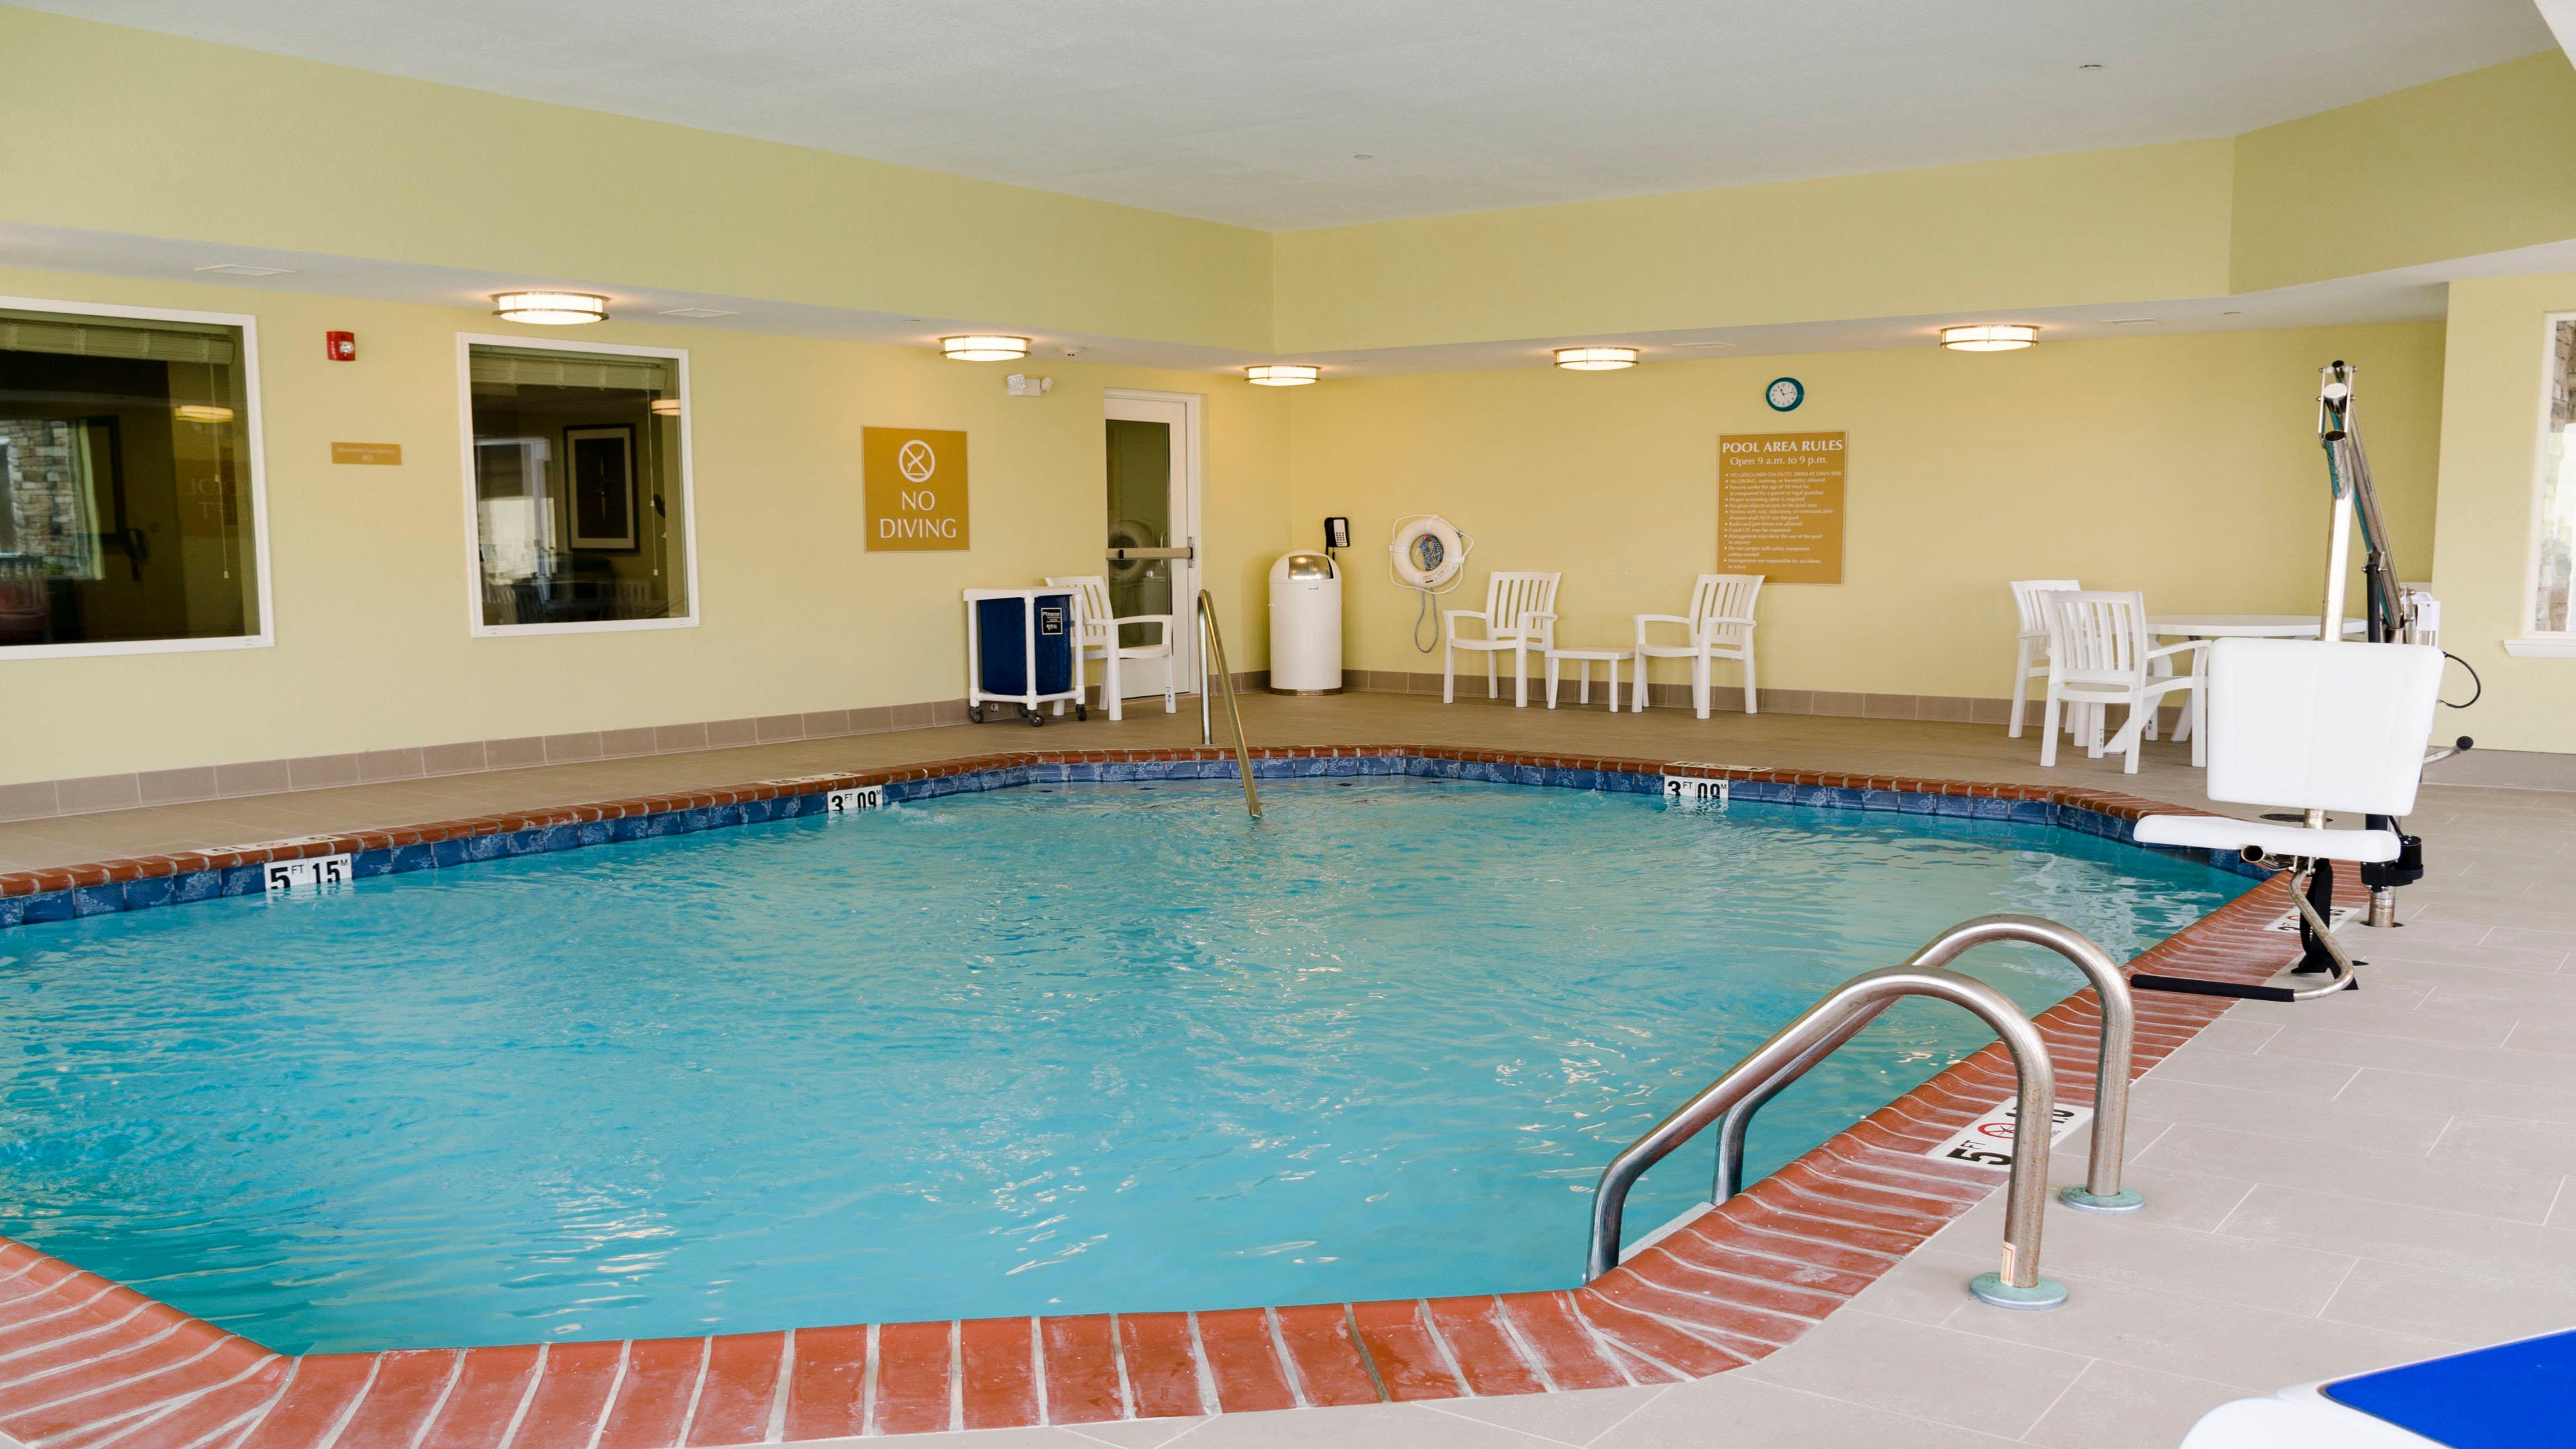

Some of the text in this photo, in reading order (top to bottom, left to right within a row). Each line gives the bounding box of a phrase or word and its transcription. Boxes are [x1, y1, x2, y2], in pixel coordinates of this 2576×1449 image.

[1722, 439, 1843, 453] POOL AREA RULES
[1729, 457, 1755, 468] Open
[1757, 457, 1764, 465] 9
[1799, 456, 1805, 464] 9
[1808, 458, 1828, 466] p.m.
[902, 490, 935, 511] NO
[880, 518, 957, 538] DIVING
[1668, 781, 1681, 796] 3
[1682, 782, 1693, 790] FT
[831, 795, 844, 812] 3
[845, 793, 853, 801] FT
[270, 858, 348, 890] 5 FT 15 M
[1960, 1139, 1987, 1150] FT
[1946, 1147, 2012, 1165] 5
